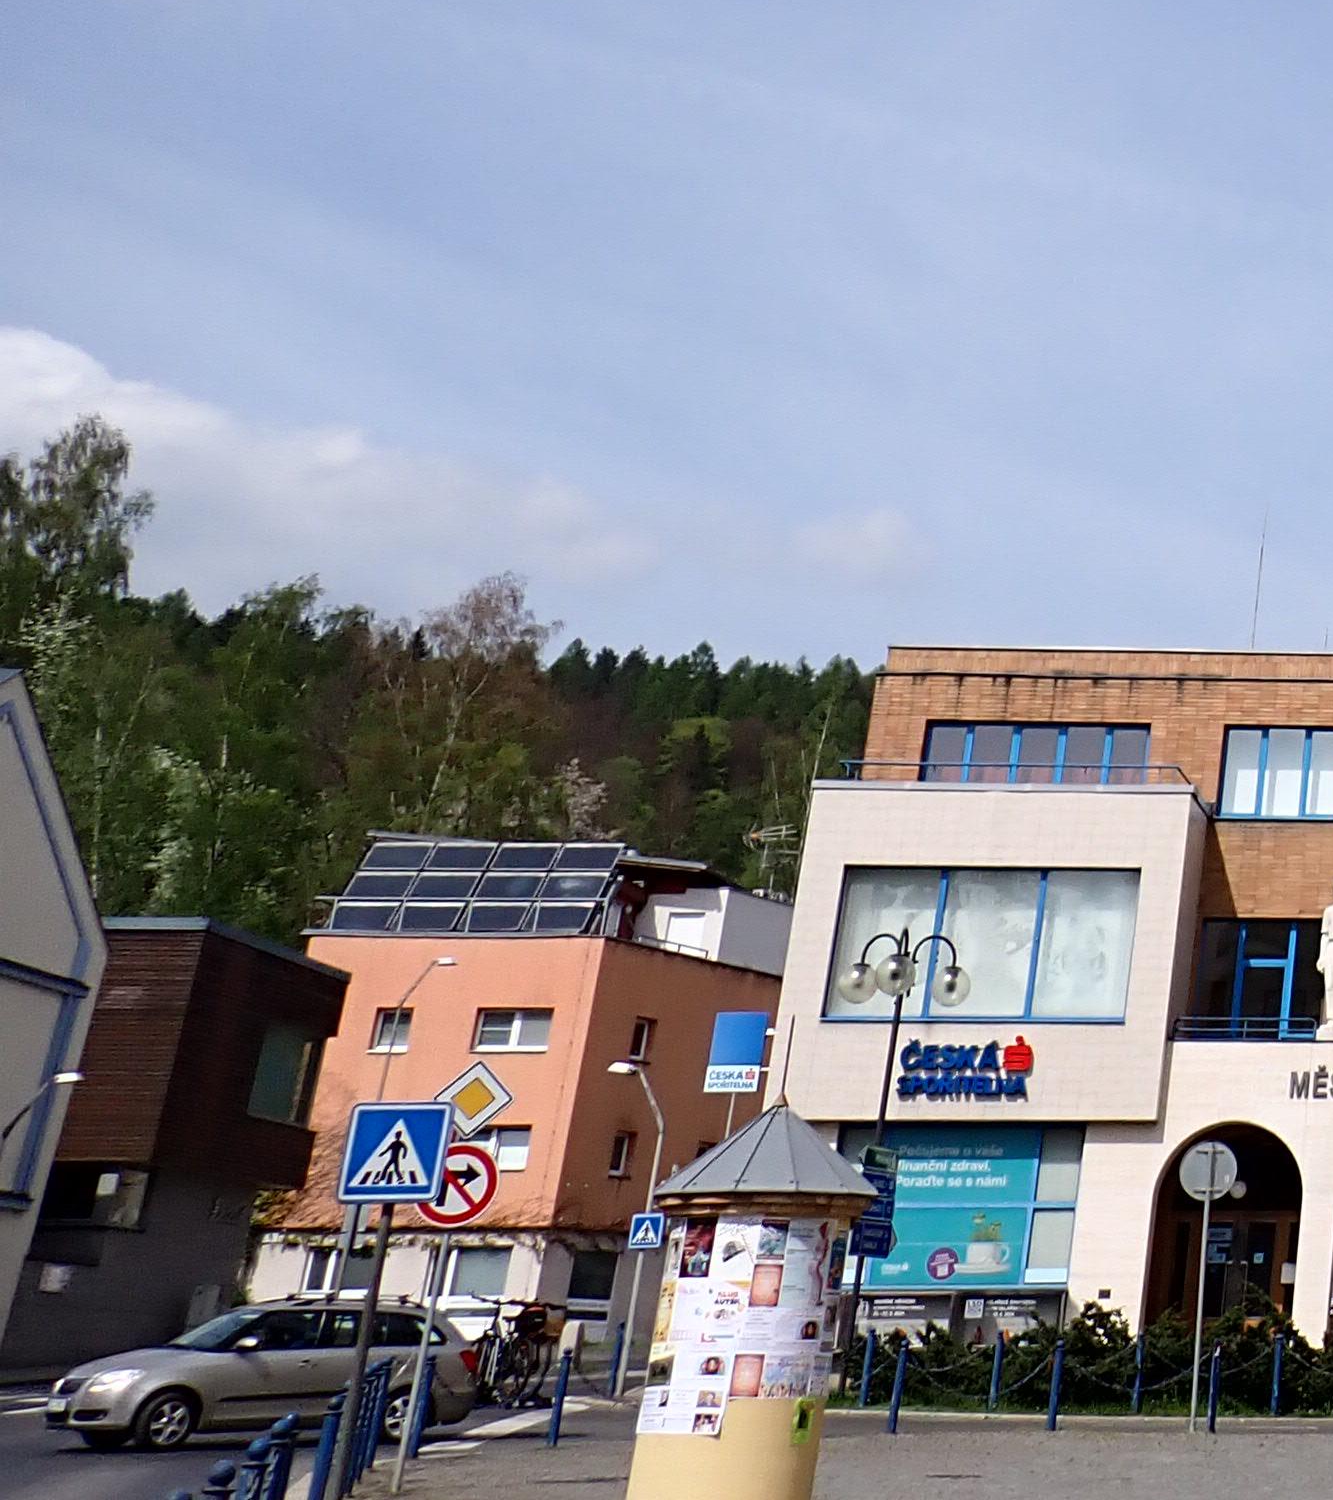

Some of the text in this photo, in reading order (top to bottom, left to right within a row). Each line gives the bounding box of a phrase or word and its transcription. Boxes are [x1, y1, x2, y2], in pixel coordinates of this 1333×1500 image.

[900, 1038, 999, 1071] ČESKÁ
[709, 1069, 744, 1080] ČESKÁ
[896, 1072, 1027, 1095] SPOŘITELNA
